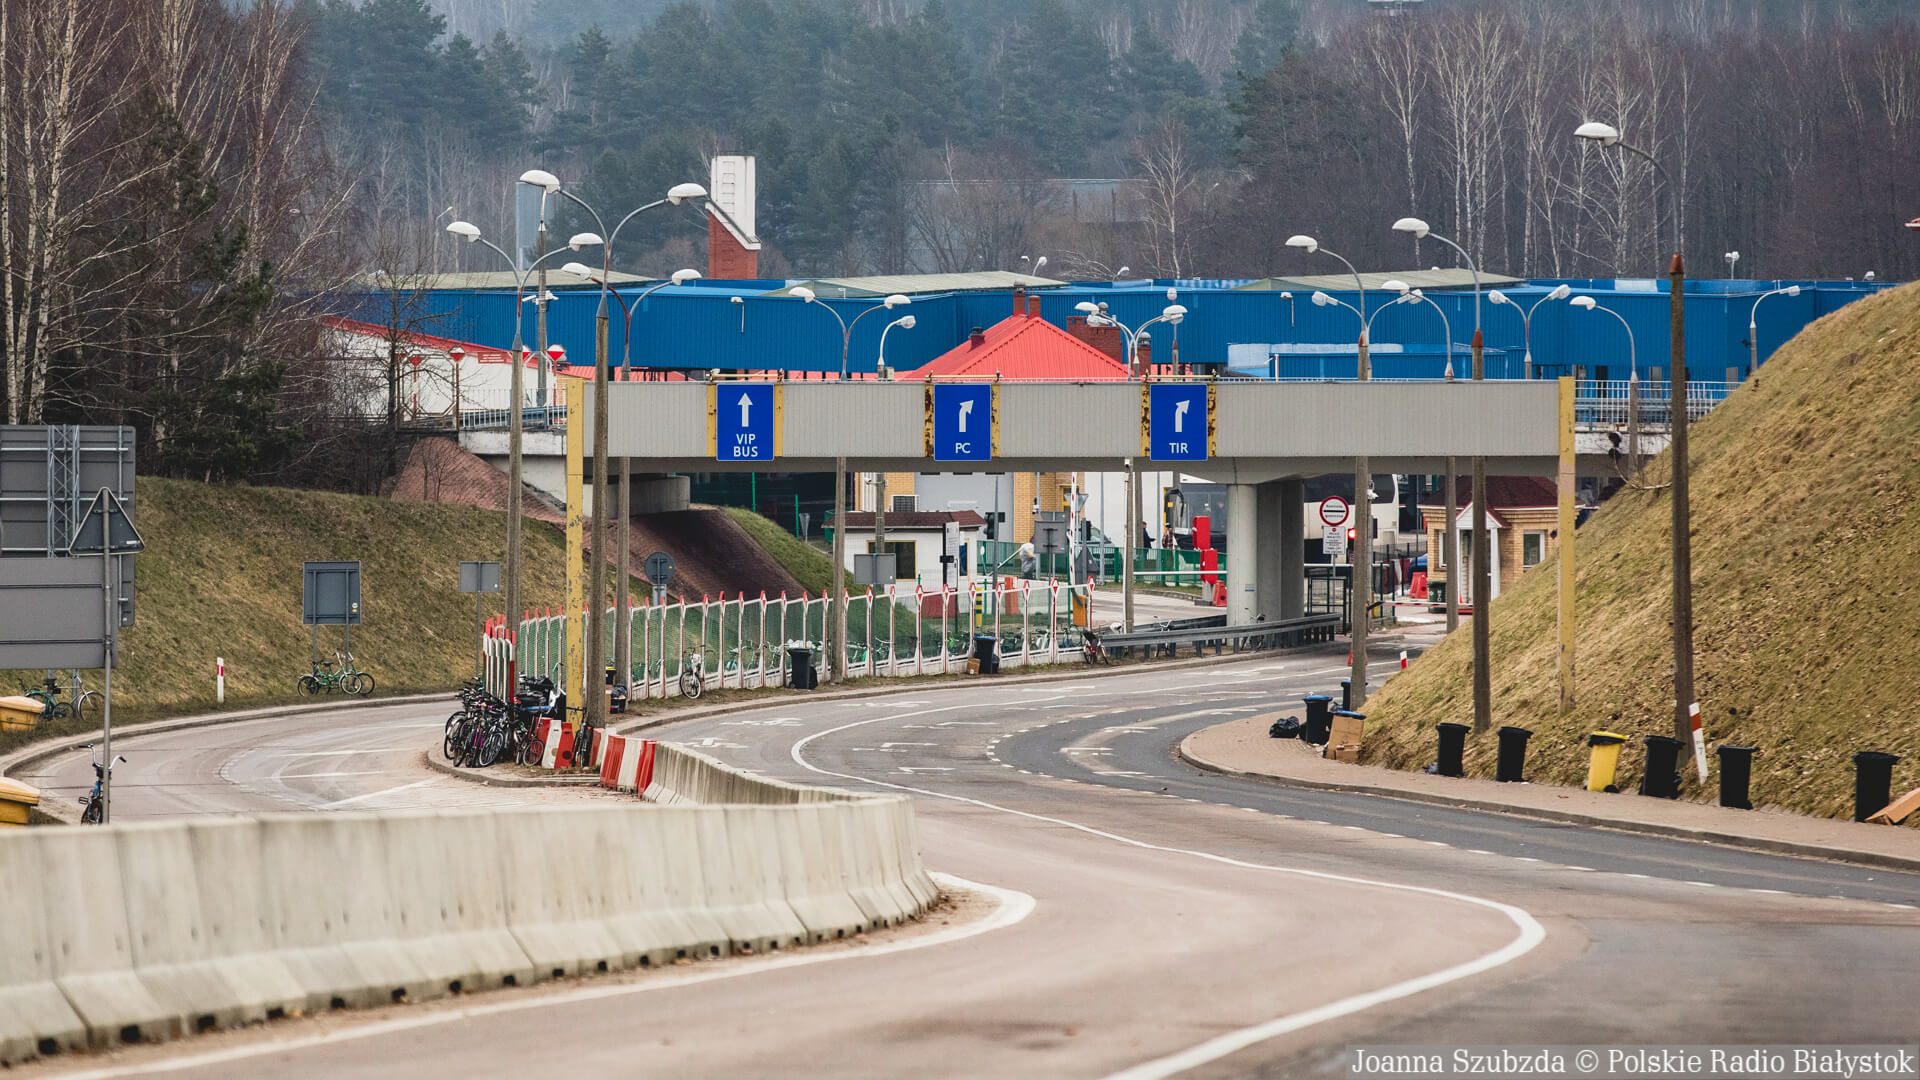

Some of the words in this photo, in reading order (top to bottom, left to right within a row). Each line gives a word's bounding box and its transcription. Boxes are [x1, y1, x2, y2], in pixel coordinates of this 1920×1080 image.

[736, 433, 756, 445] VIP
[733, 446, 758, 457] BUS
[955, 442, 971, 454] PC
[1169, 442, 1189, 454] TIR
